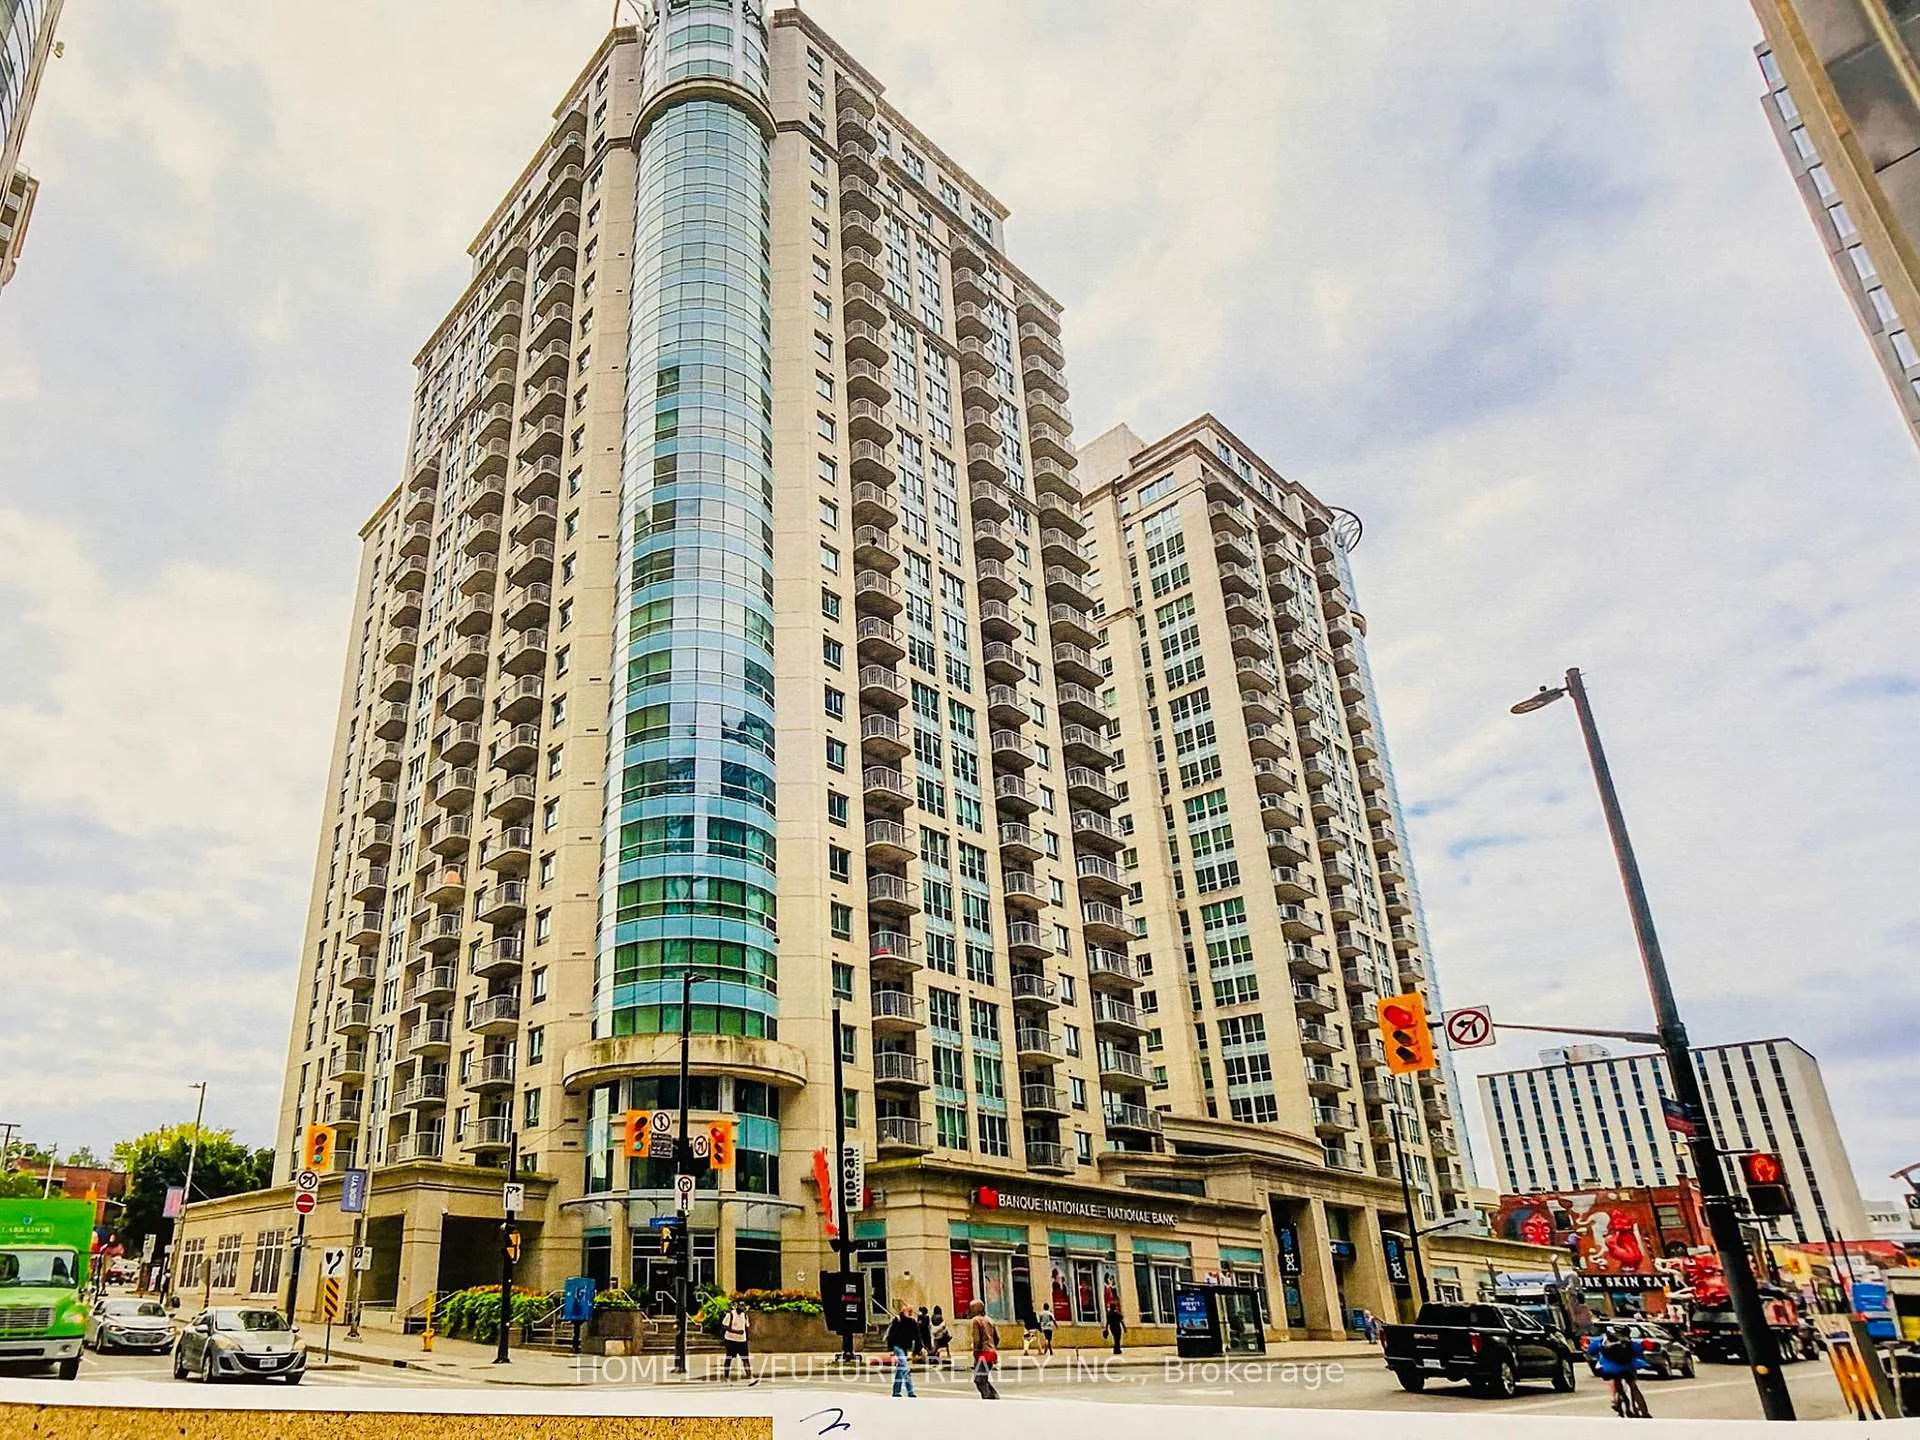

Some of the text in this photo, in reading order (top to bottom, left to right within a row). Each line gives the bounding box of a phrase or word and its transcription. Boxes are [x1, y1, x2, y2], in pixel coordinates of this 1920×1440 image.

[998, 1194, 1041, 1212] BANQUE
[1044, 1199, 1097, 1218] NATIONALE
[1151, 1212, 1179, 1227] BANK
[1606, 1276, 1640, 1288] SKIN
